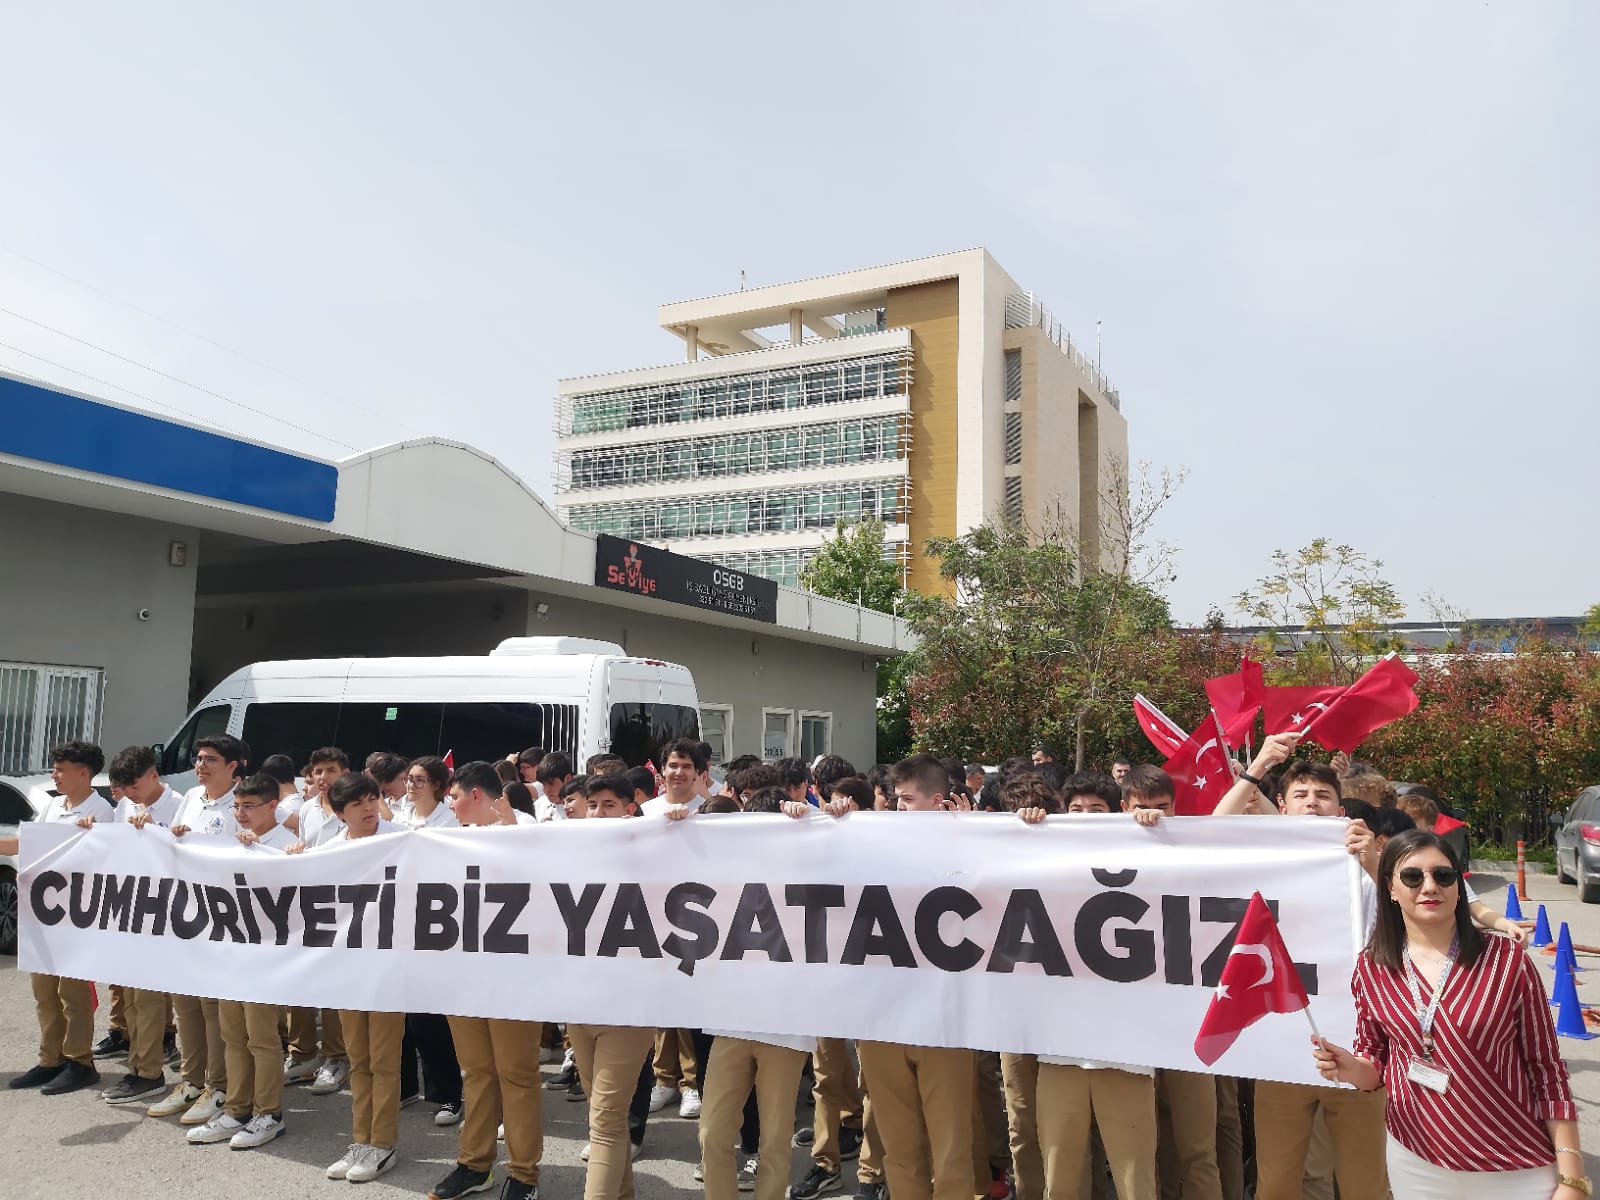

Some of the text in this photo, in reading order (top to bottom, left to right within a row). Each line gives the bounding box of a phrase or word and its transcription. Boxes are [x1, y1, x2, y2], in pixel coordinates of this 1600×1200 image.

[713, 569, 744, 591] OSGB
[30, 865, 398, 950] CUMHURİYETİ
[413, 865, 532, 955] BİZ
